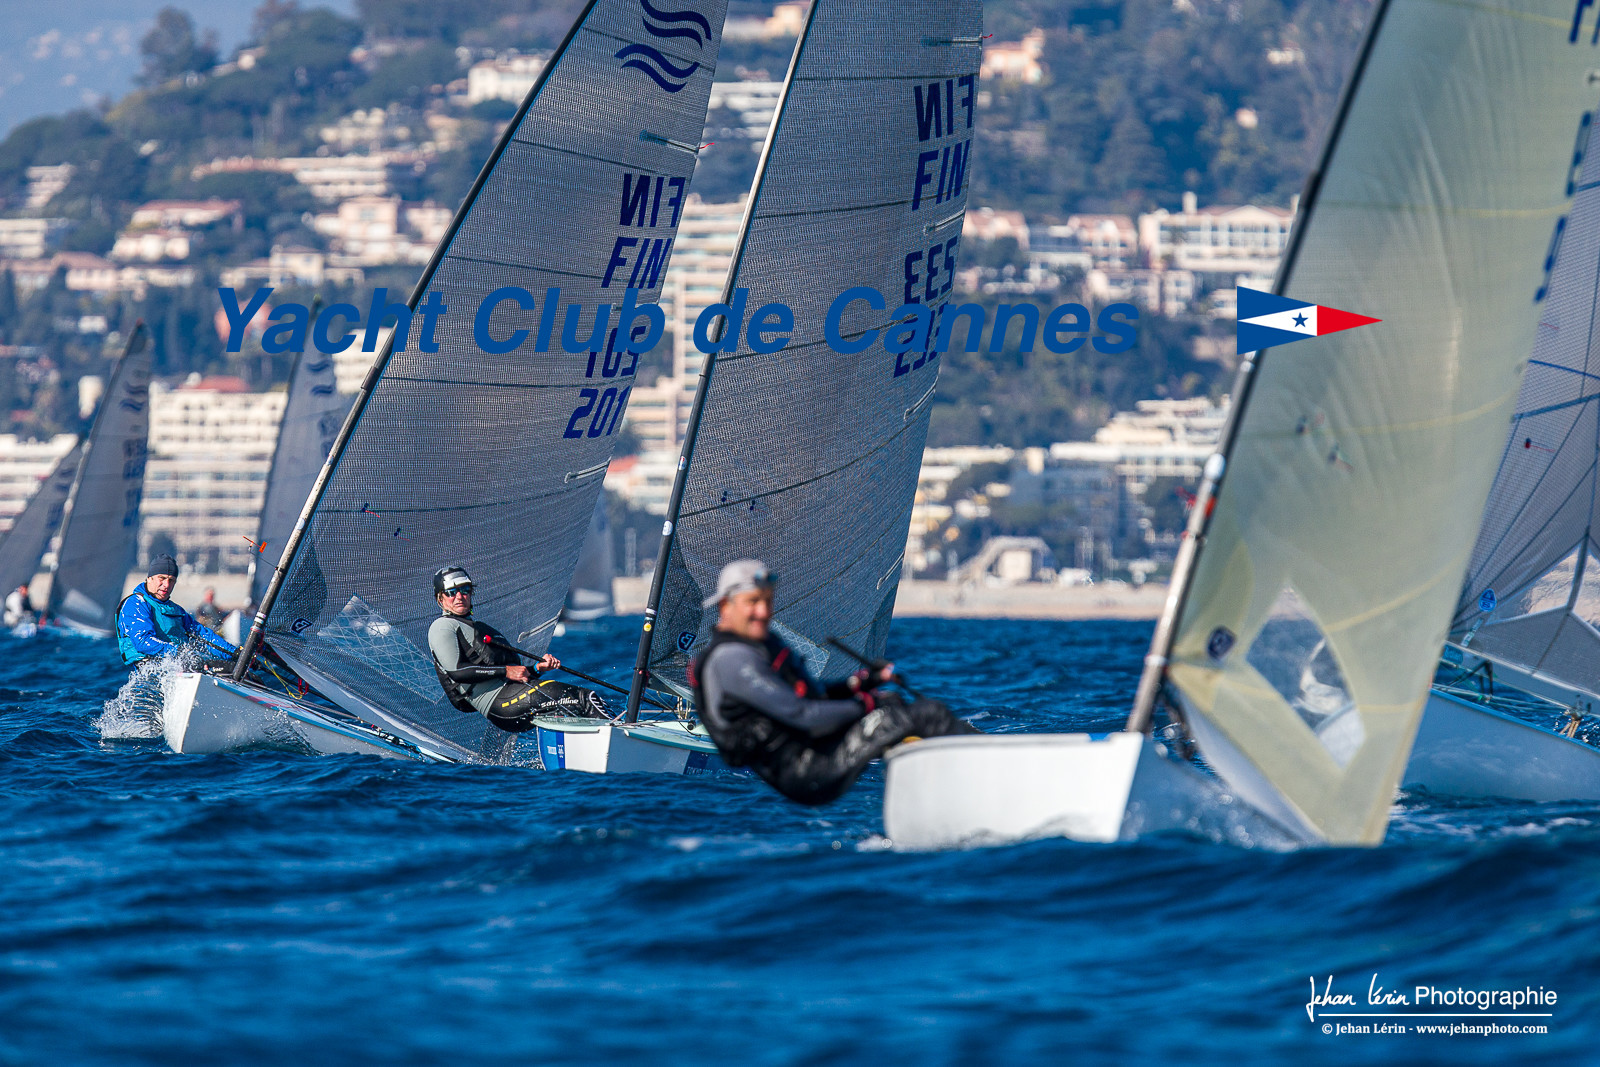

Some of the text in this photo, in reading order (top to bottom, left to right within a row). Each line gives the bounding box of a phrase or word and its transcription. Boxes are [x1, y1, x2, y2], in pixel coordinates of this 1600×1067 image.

[911, 139, 970, 211] FIN
[601, 236, 672, 289] FIN
[562, 386, 631, 439] 201
